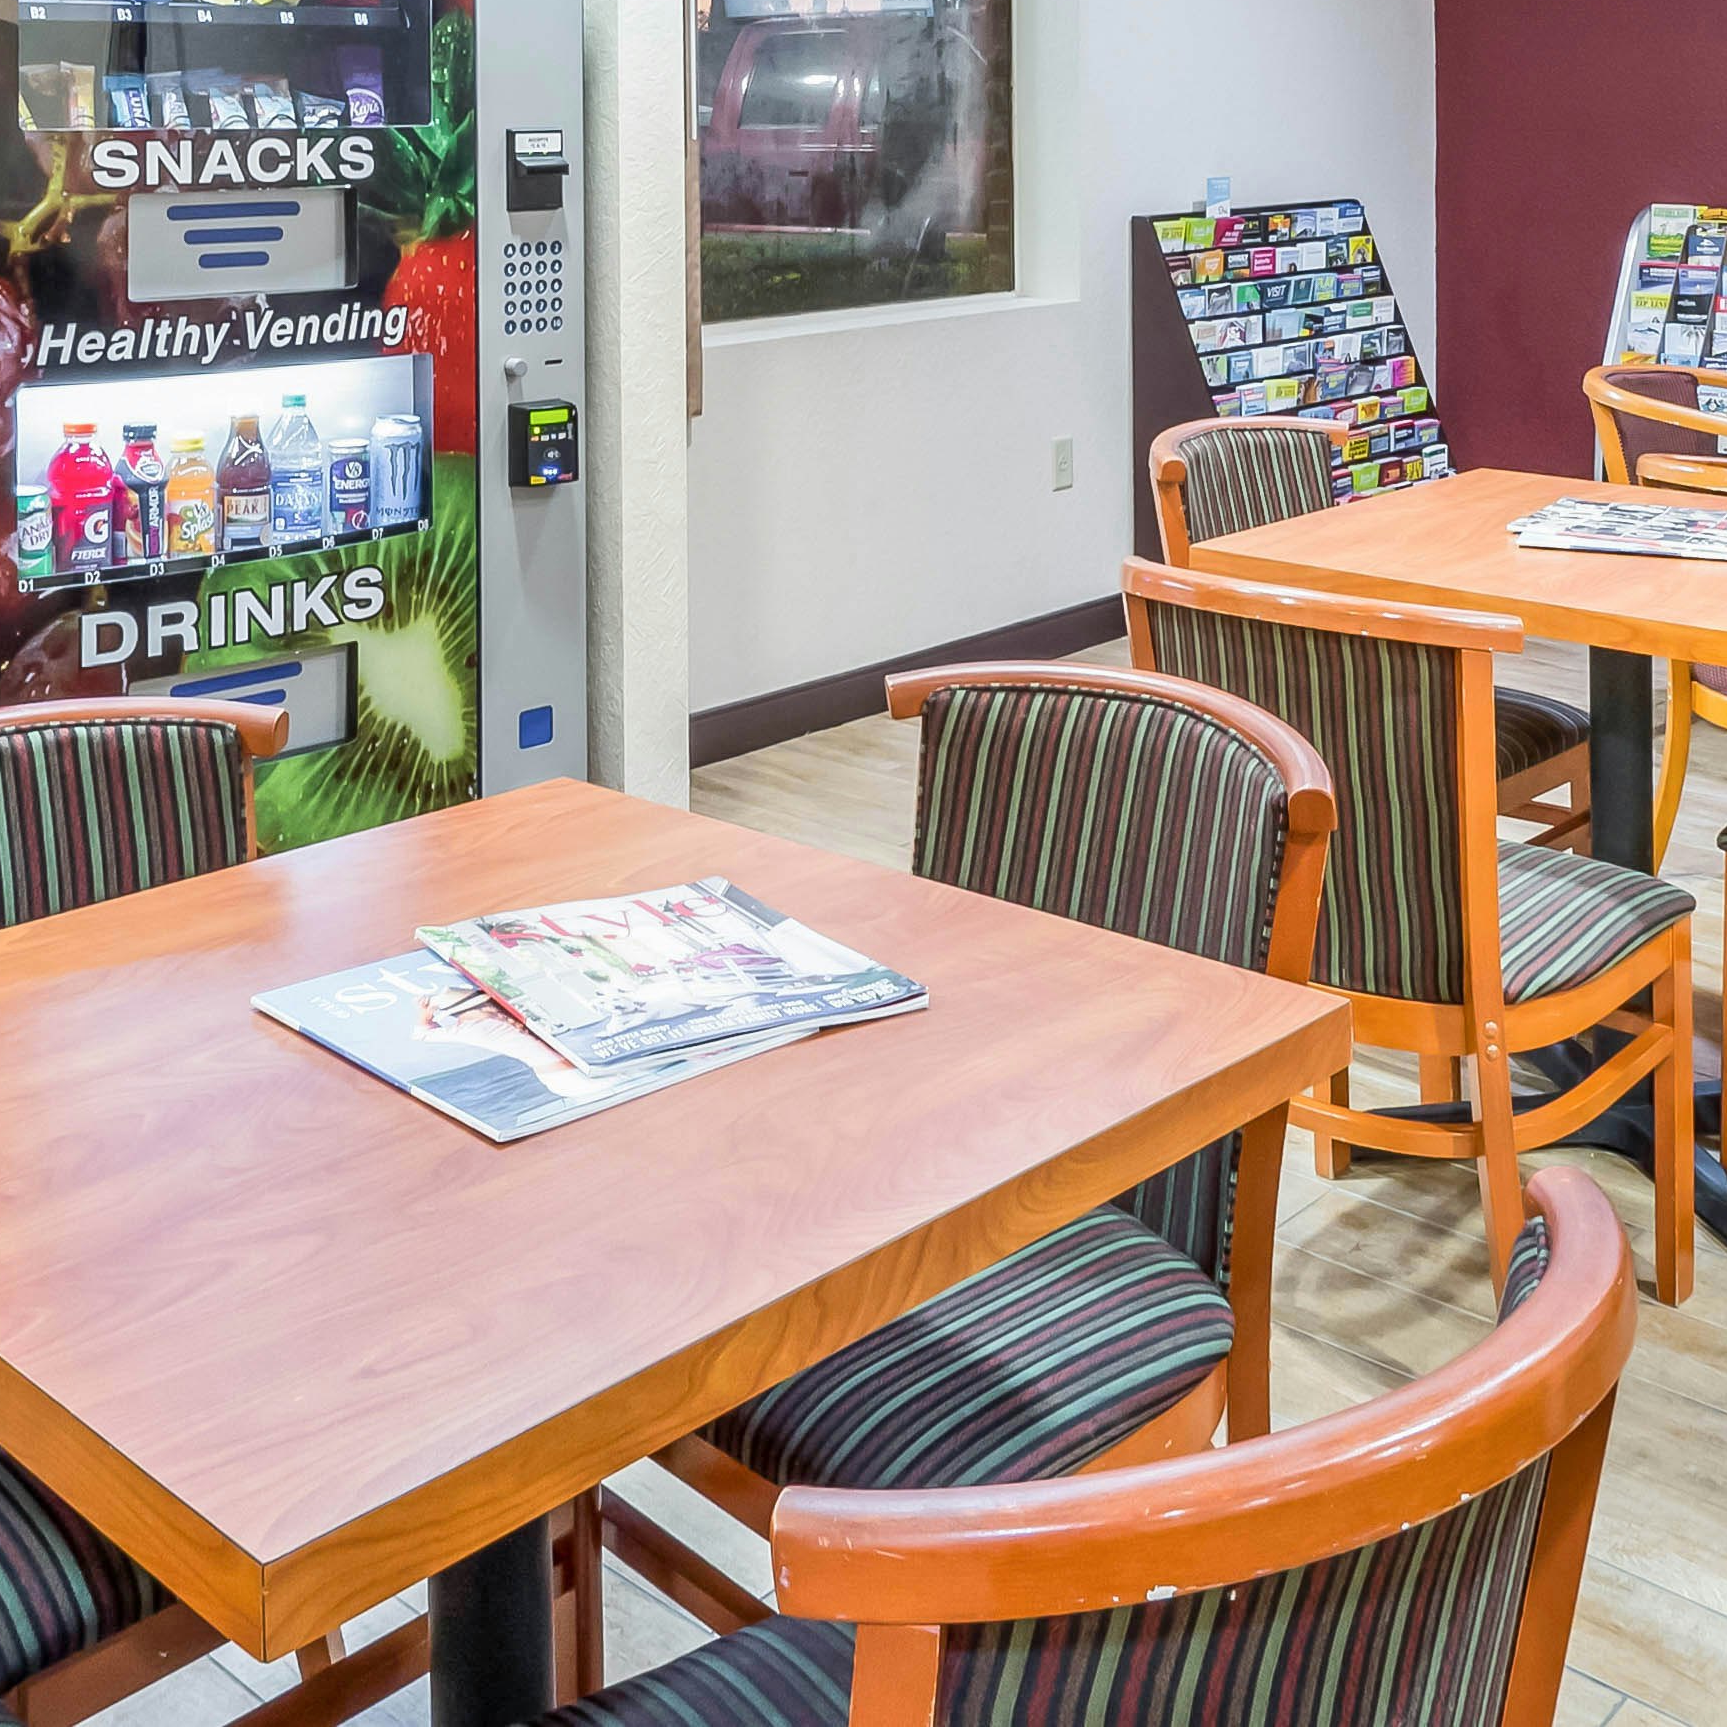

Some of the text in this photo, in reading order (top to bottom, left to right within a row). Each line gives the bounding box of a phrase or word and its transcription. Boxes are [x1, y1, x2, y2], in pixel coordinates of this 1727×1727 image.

[92, 135, 375, 188] SNACKS
[1266, 284, 1286, 298] VISIT
[36, 301, 408, 366] Healthy Vending
[226, 503, 259, 516] PEAK
[376, 506, 420, 518] MONST
[83, 509, 110, 544] G
[372, 527, 384, 540] D7
[268, 545, 283, 558] D5
[211, 554, 225, 567] D4
[149, 563, 165, 577] D3
[84, 571, 101, 584] D2
[18, 580, 34, 593] D1
[81, 566, 384, 668] DRINKS
